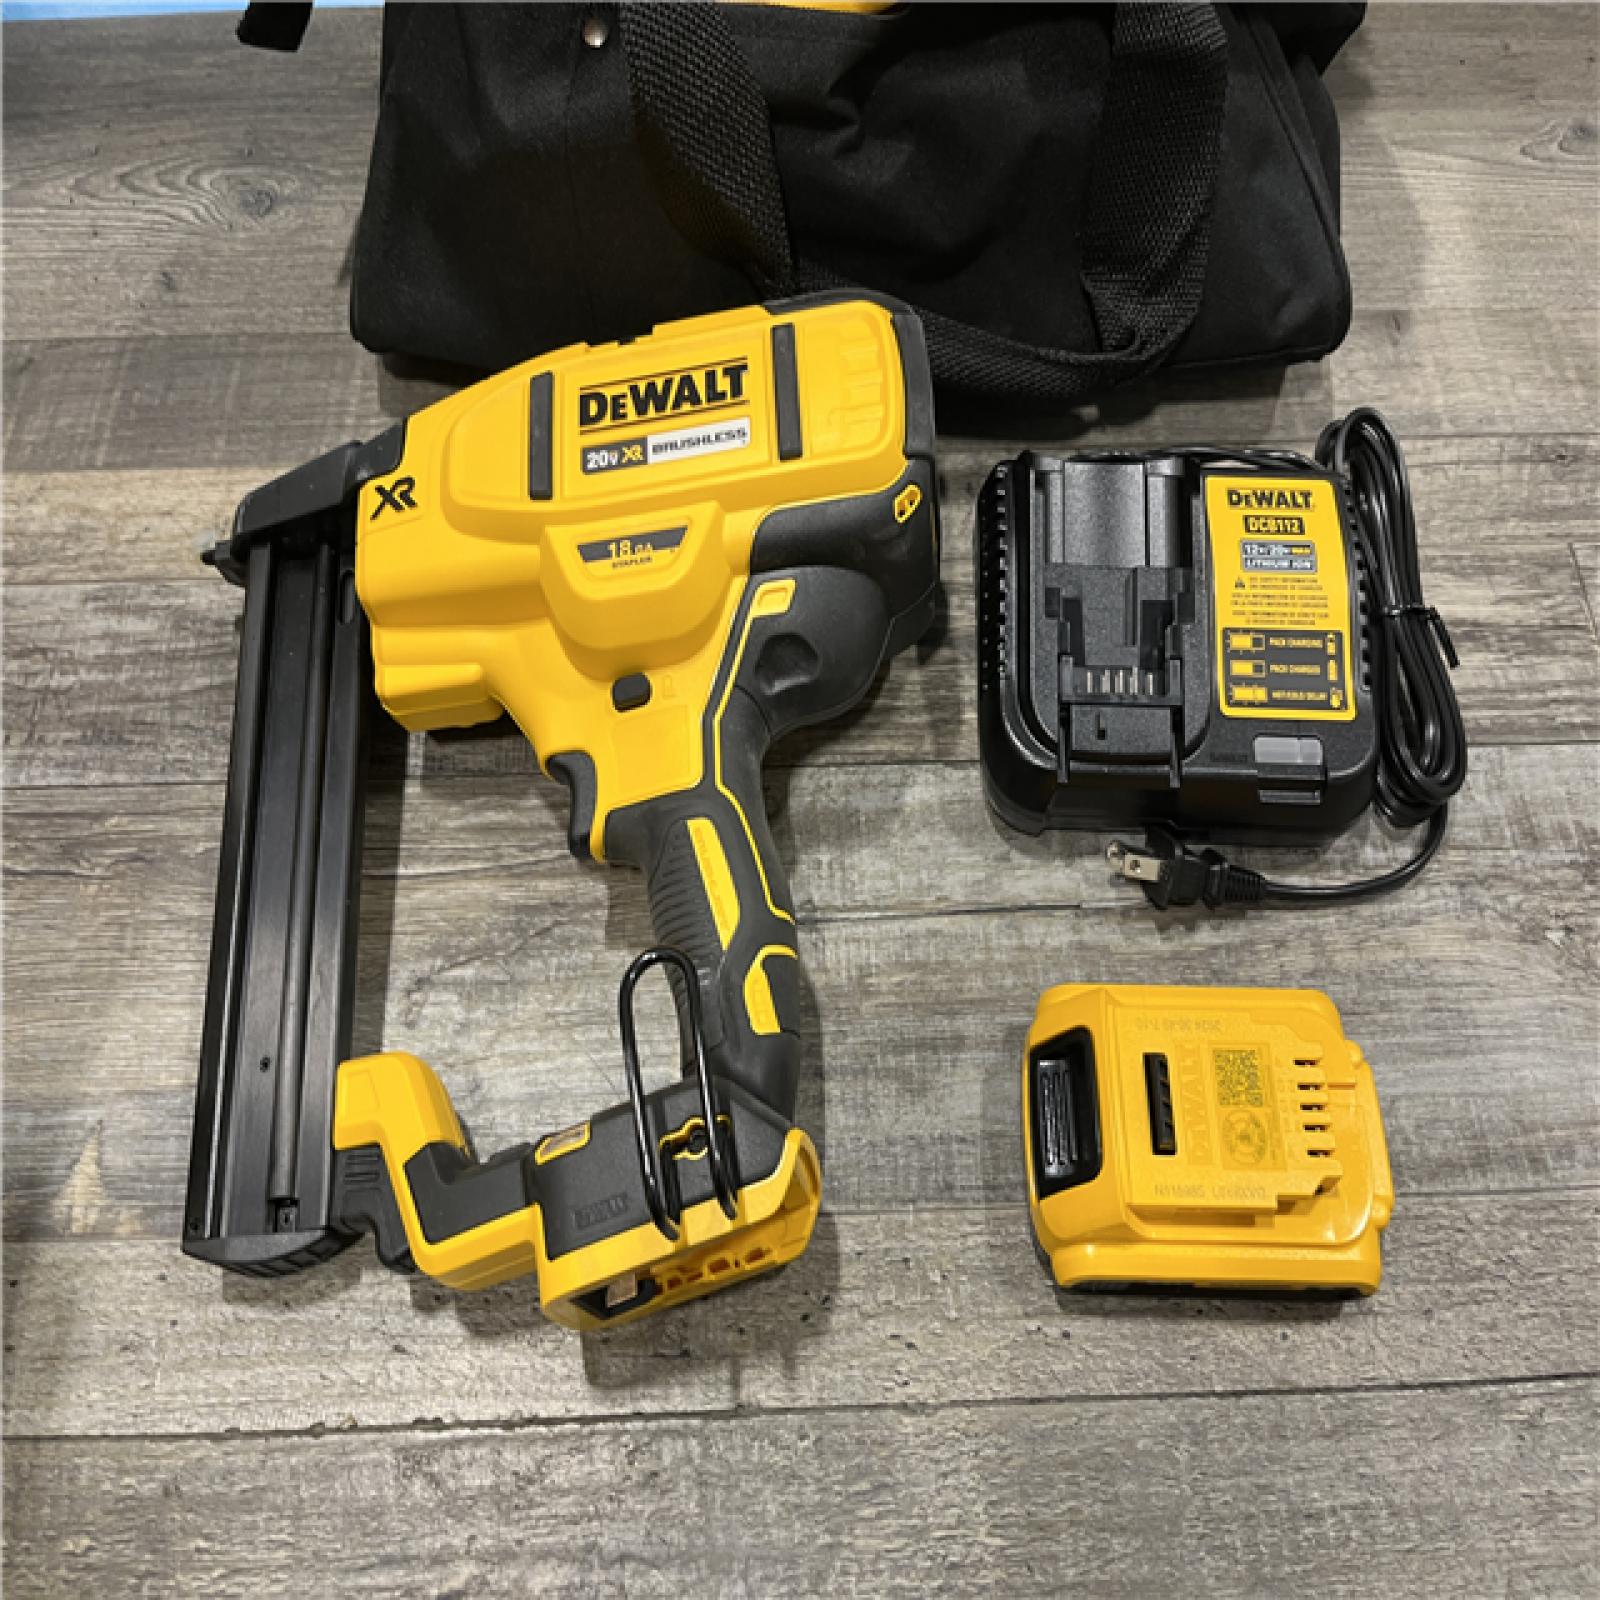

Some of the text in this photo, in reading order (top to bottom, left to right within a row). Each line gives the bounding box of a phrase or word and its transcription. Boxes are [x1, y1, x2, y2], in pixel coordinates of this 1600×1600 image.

[579, 364, 748, 426] DEWALT
[652, 426, 747, 456] BRUSHLESS
[369, 475, 418, 521] XR
